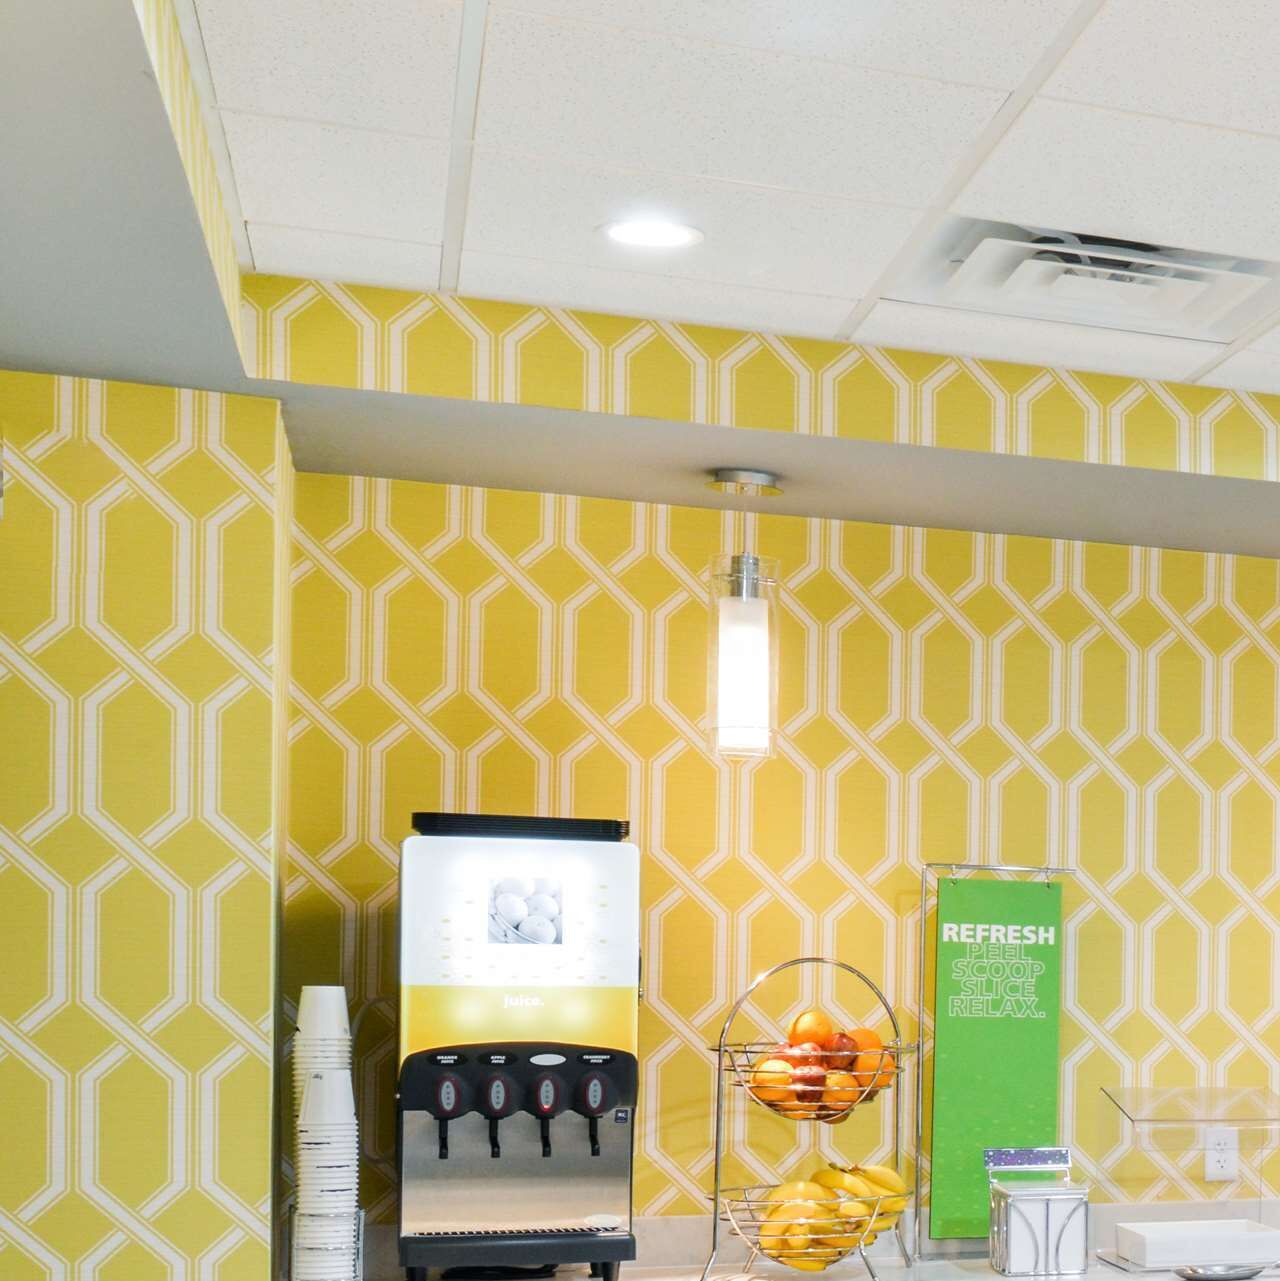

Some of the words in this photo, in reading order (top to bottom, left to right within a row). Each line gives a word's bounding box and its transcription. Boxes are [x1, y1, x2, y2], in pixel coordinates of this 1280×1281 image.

[943, 923, 1055, 945] REFRESH
[967, 942, 1032, 961] PEEL
[952, 959, 1046, 980] SCOOP
[960, 978, 1036, 999] SLICE
[949, 996, 1046, 1018] RELAX.
